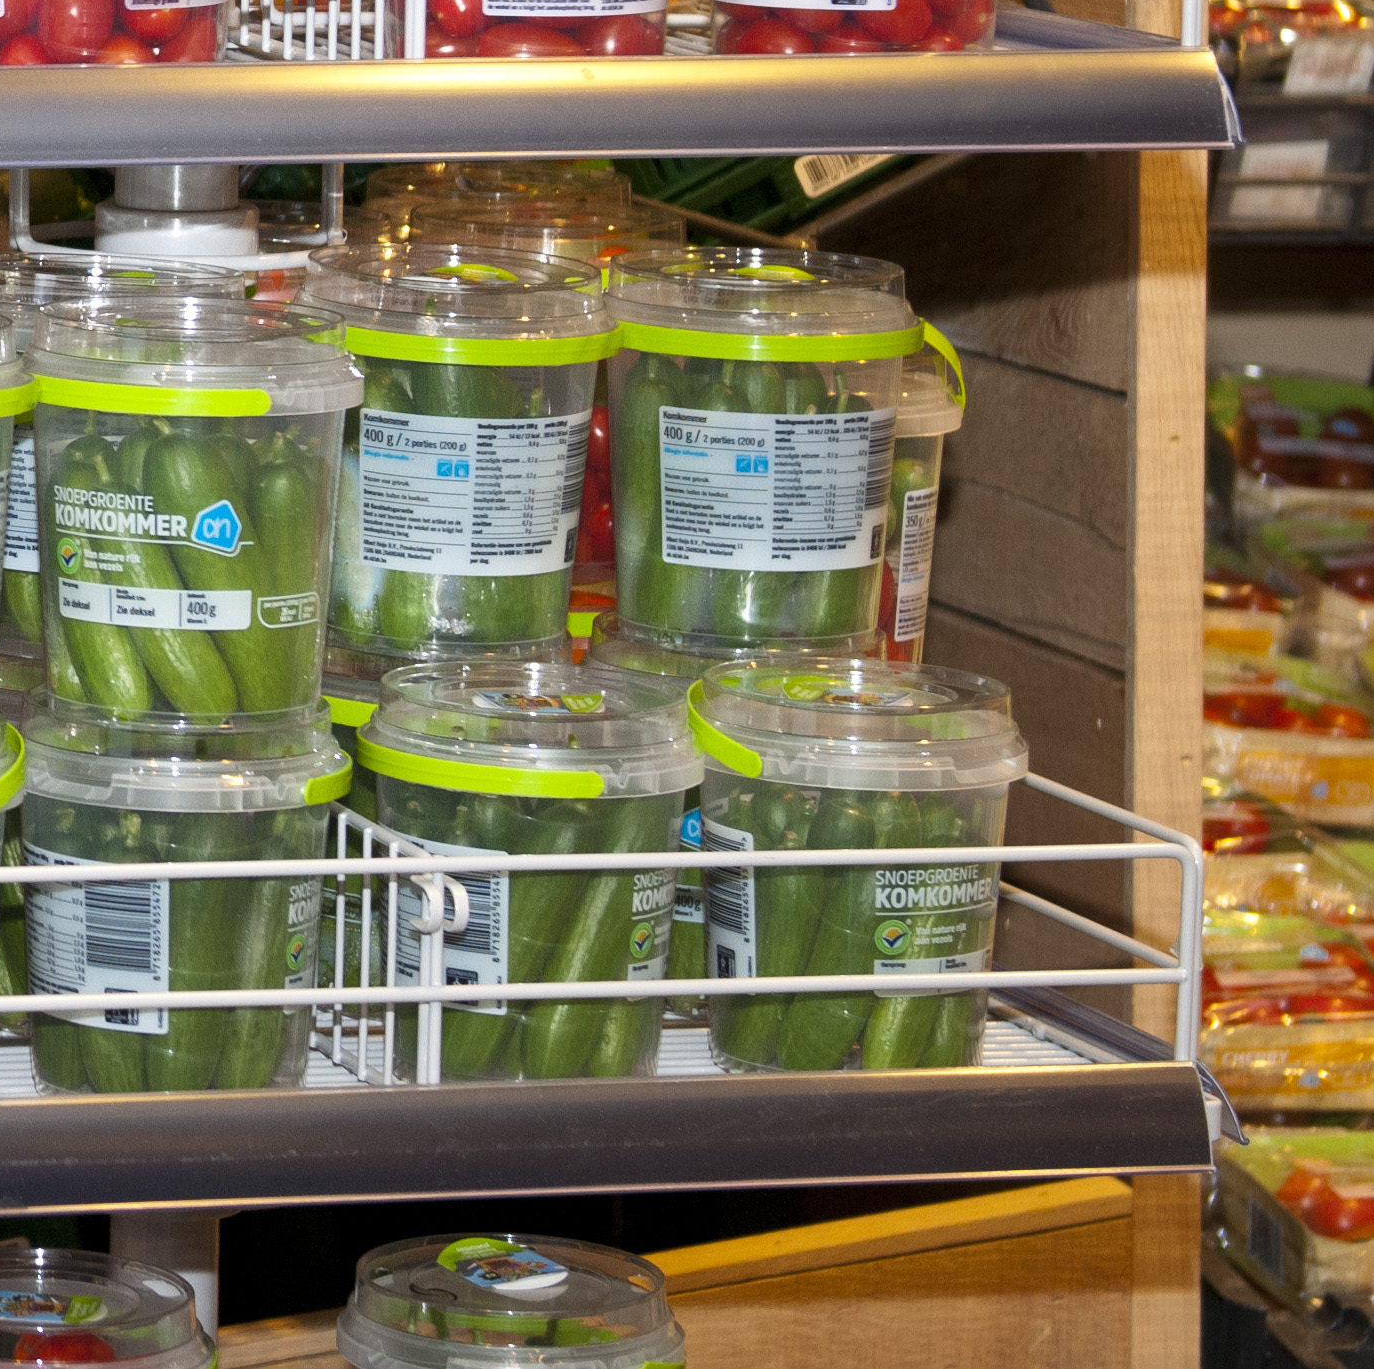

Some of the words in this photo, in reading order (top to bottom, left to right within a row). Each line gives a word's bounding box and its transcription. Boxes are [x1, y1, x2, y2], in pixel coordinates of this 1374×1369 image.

[364, 428, 384, 443] 400
[412, 439, 438, 449] porties
[664, 426, 683, 440] 400
[710, 435, 736, 445] porties
[53, 485, 154, 512] SNOEPGROENTE
[55, 503, 188, 537] KOMKOMMER
[116, 605, 128, 615] Zie
[875, 863, 980, 886] SNOEPGROENTE
[875, 877, 993, 909] KOMKOMMER
